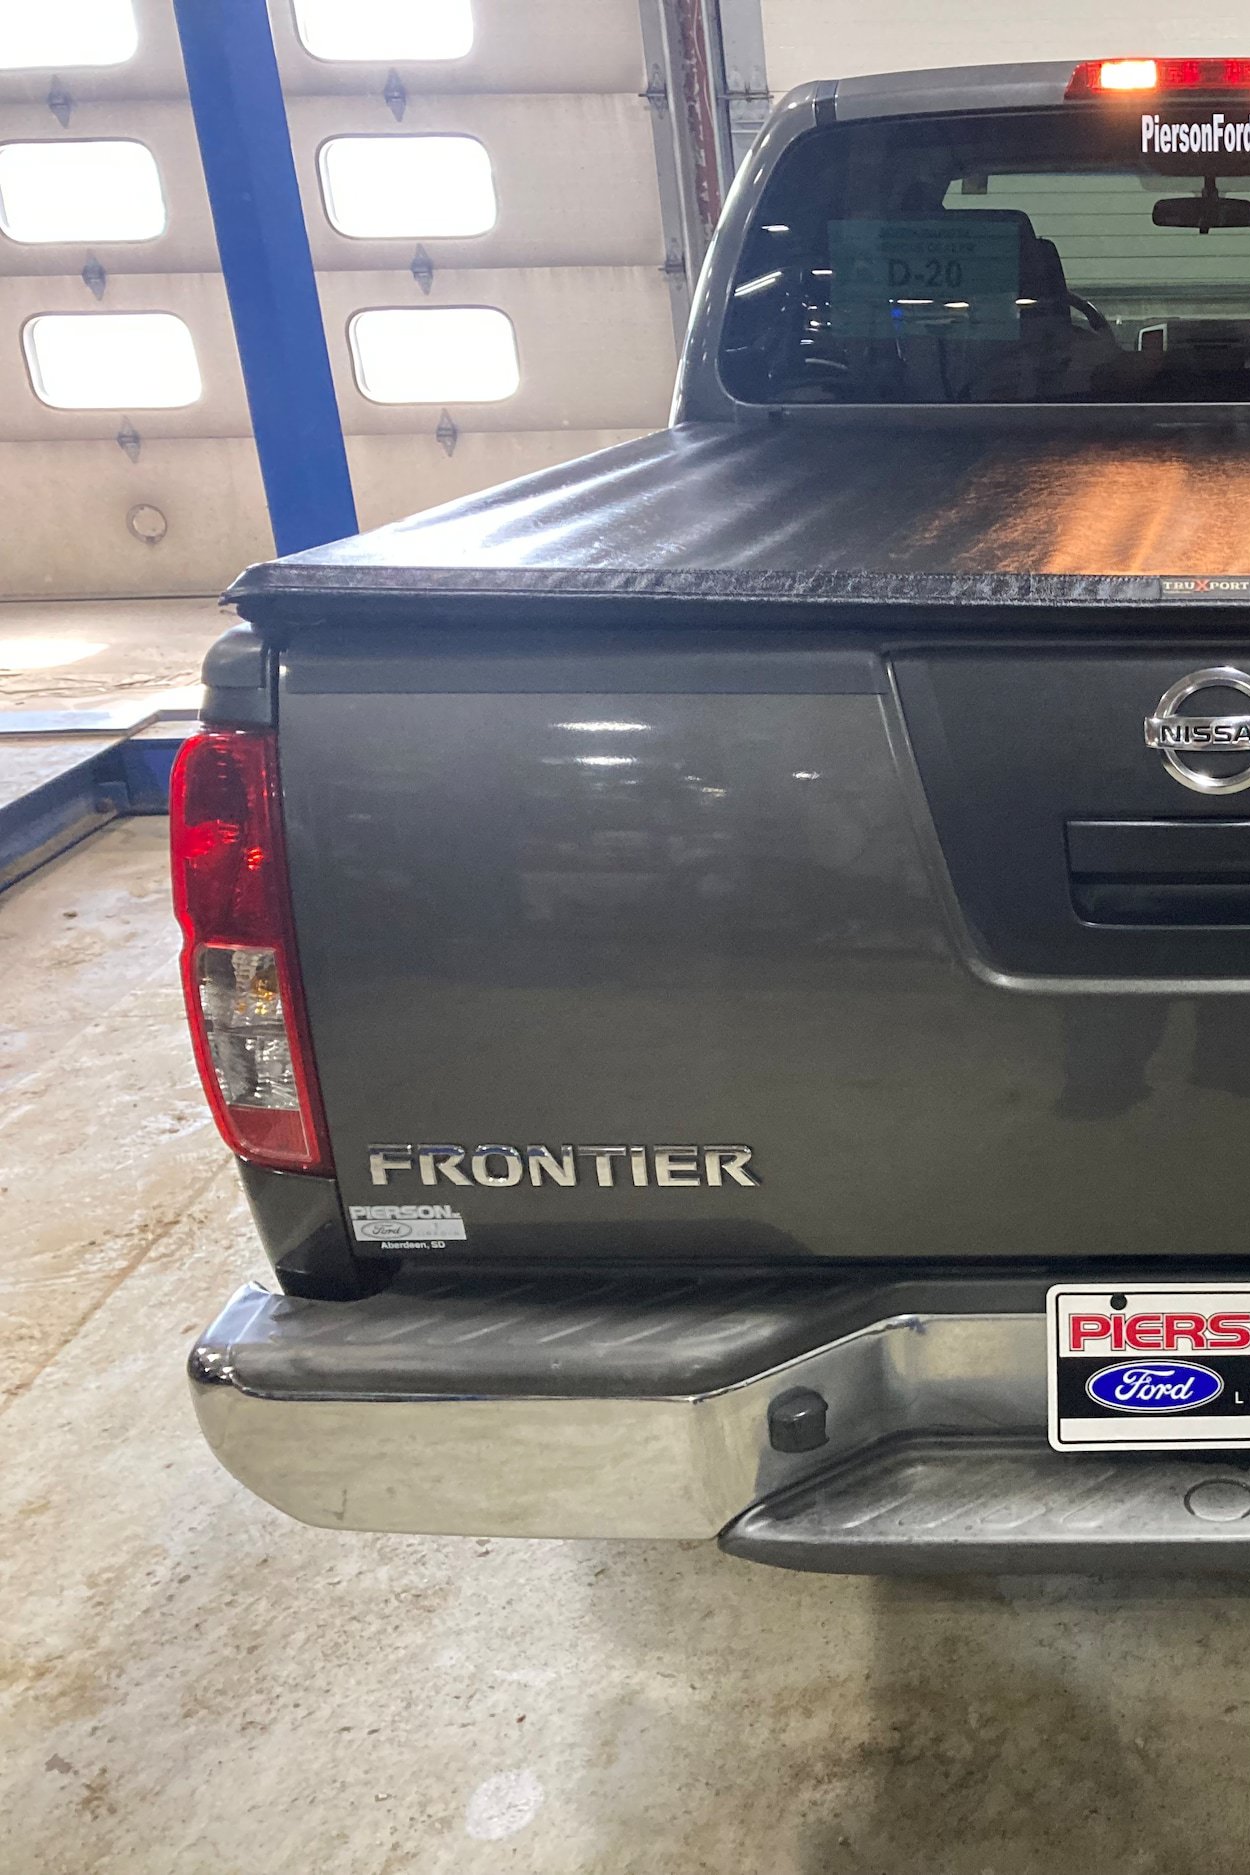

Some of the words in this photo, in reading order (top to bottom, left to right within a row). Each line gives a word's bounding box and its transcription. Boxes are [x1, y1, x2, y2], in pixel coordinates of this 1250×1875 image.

[888, 259, 963, 288] D-20
[1163, 579, 1249, 592] TRUXPORT
[368, 1144, 760, 1187] FRONTIER
[348, 1205, 452, 1219] PIERSON
[381, 1240, 430, 1249] Aberdeen,
[430, 1240, 446, 1249] SD
[1115, 1369, 1195, 1401] Ford
